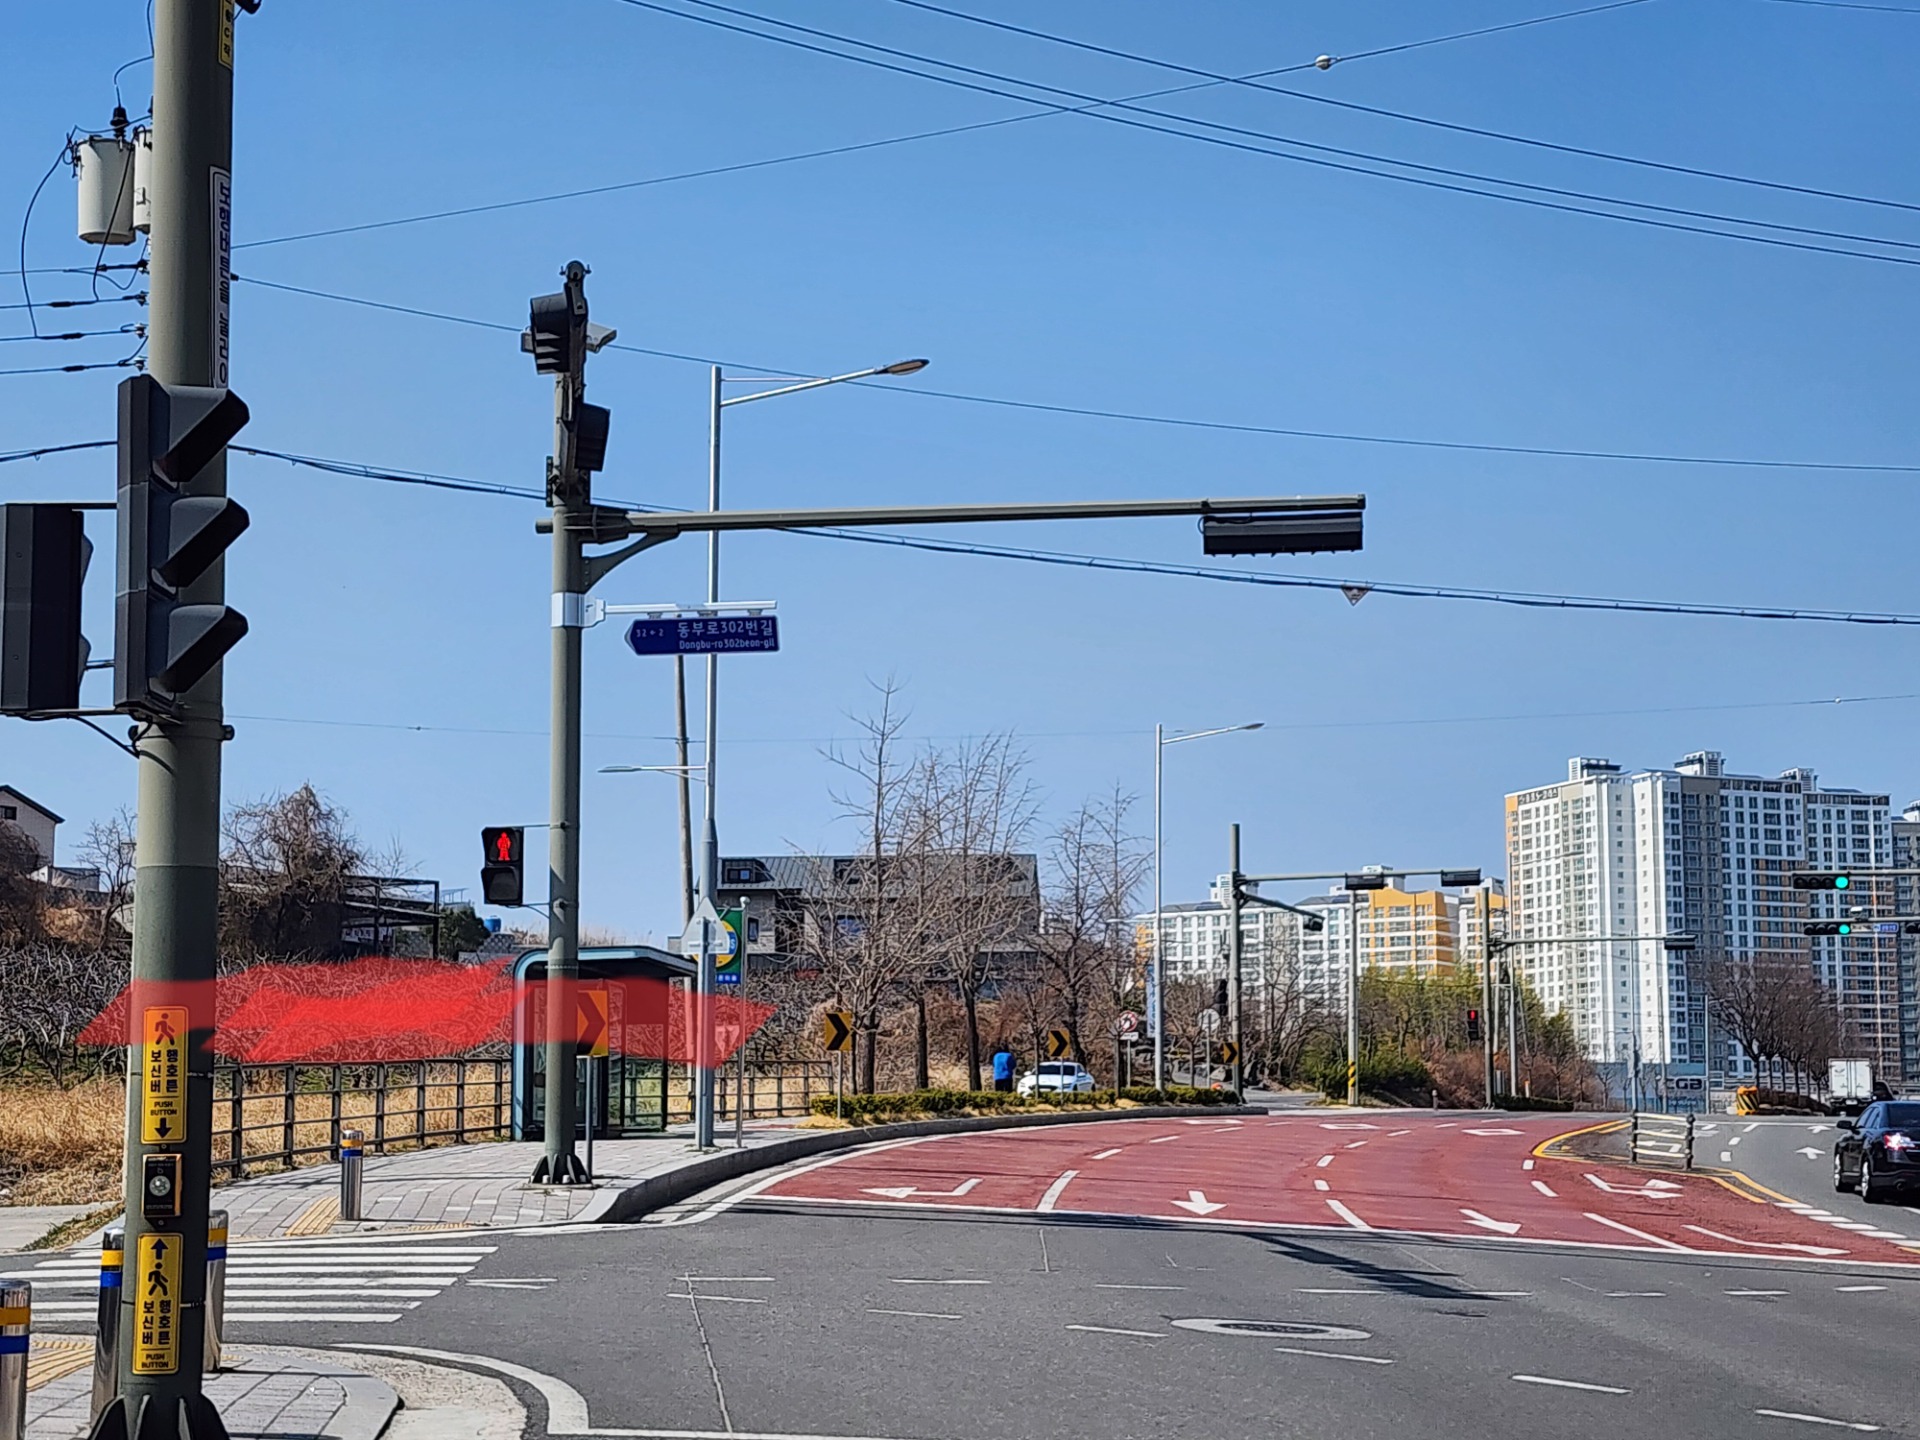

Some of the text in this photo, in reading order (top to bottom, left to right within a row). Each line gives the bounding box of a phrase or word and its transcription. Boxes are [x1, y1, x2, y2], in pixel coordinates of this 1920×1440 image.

[677, 621, 773, 638] 동부로302번길
[150, 1049, 178, 1063] 보행
[150, 1064, 179, 1079] 신호
[150, 1080, 178, 1093] 버튼
[150, 1108, 178, 1116] BUTTON
[143, 1299, 172, 1314] 보행
[142, 1315, 171, 1330] 신호
[142, 1331, 171, 1345] 버튼
[145, 1353, 165, 1361] PUSH
[141, 1361, 169, 1369] BUTTON
